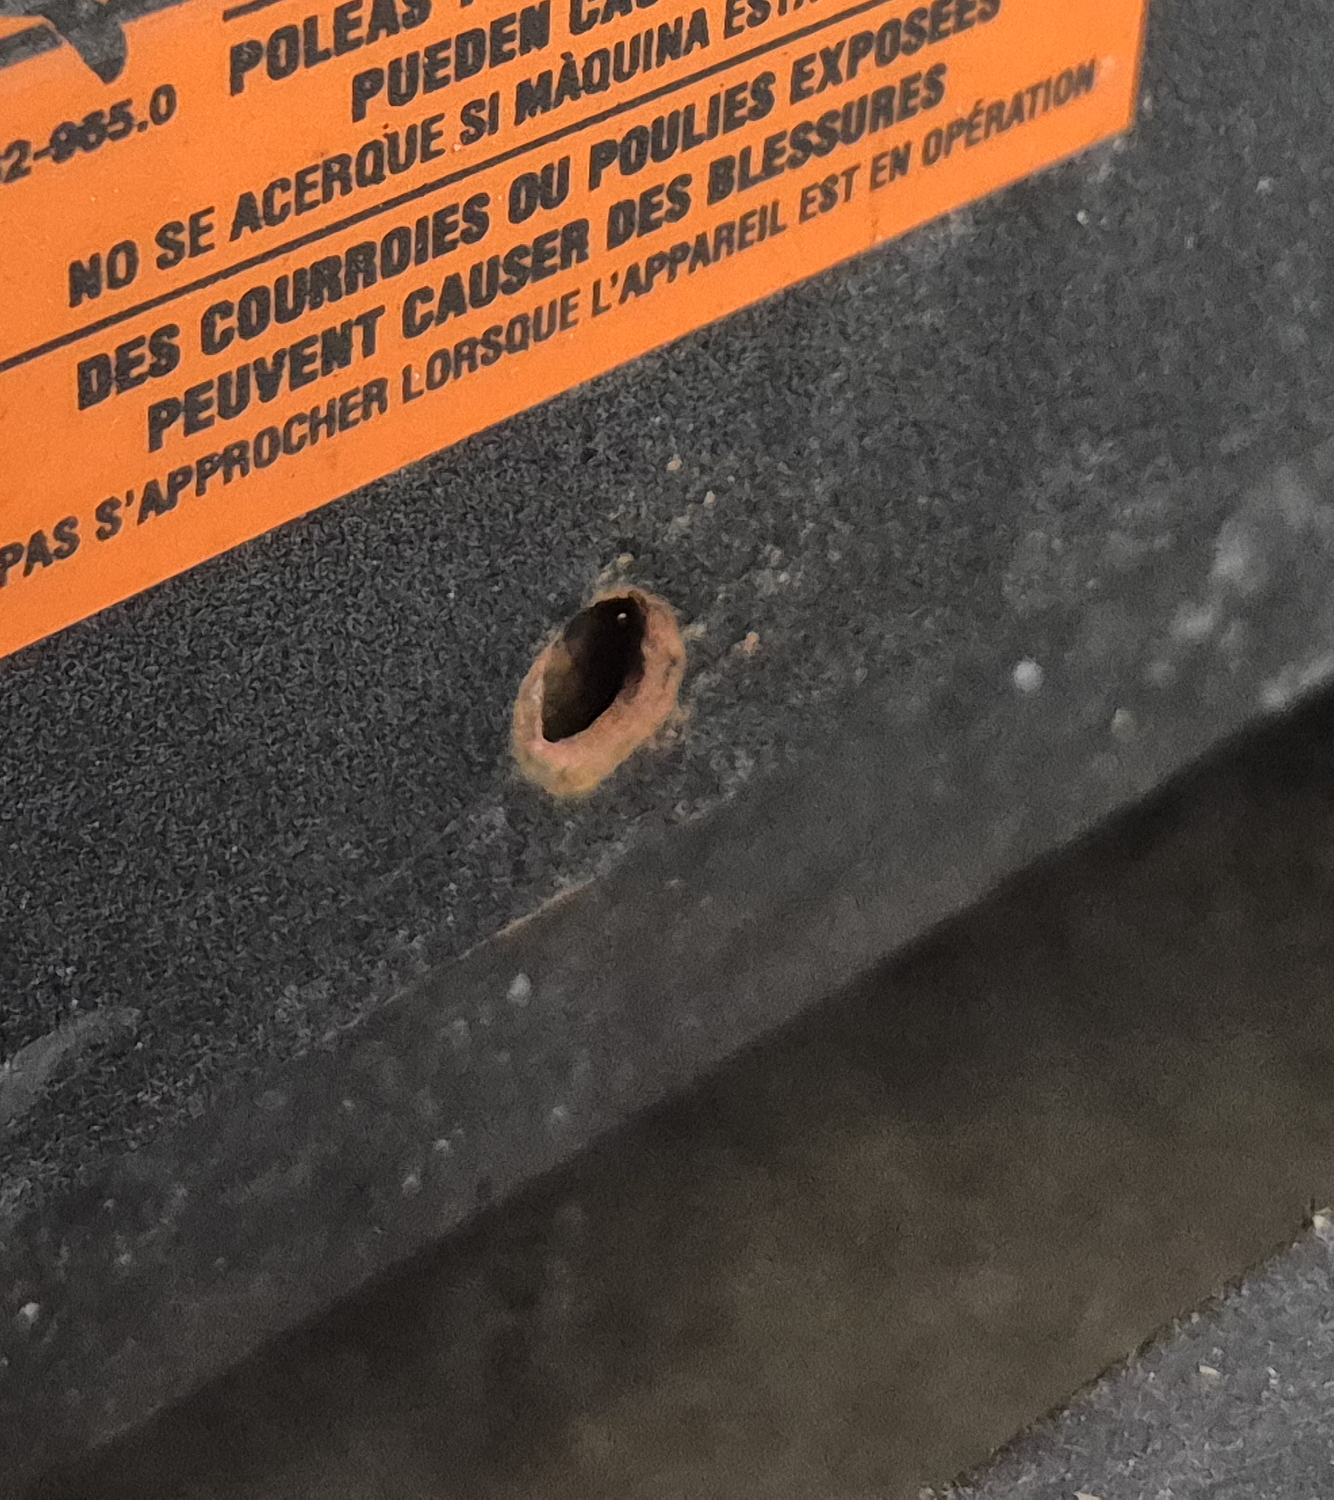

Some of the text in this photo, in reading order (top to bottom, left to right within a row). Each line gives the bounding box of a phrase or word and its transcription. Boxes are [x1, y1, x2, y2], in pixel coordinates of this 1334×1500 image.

[69, 240, 140, 308] NO
[155, 208, 215, 271] SE
[231, 114, 446, 241] ACERQUE
[460, 93, 501, 146] SI
[352, 0, 552, 122] PUEDEN
[78, 324, 181, 410] DES
[201, 193, 491, 356] COURROIES
[508, 158, 571, 225] OU
[589, 72, 777, 190] POULIES
[96, 378, 389, 541] S'APPROCHER
[402, 291, 579, 403] LORSQUE
[593, 203, 787, 316] L'APPAREIL
[799, 165, 860, 223] EST
[871, 144, 912, 190] EN
[922, 62, 1099, 167] OPÉRATION
[148, 64, 948, 452] PEUVENT CAUSER DES BLESSURES
